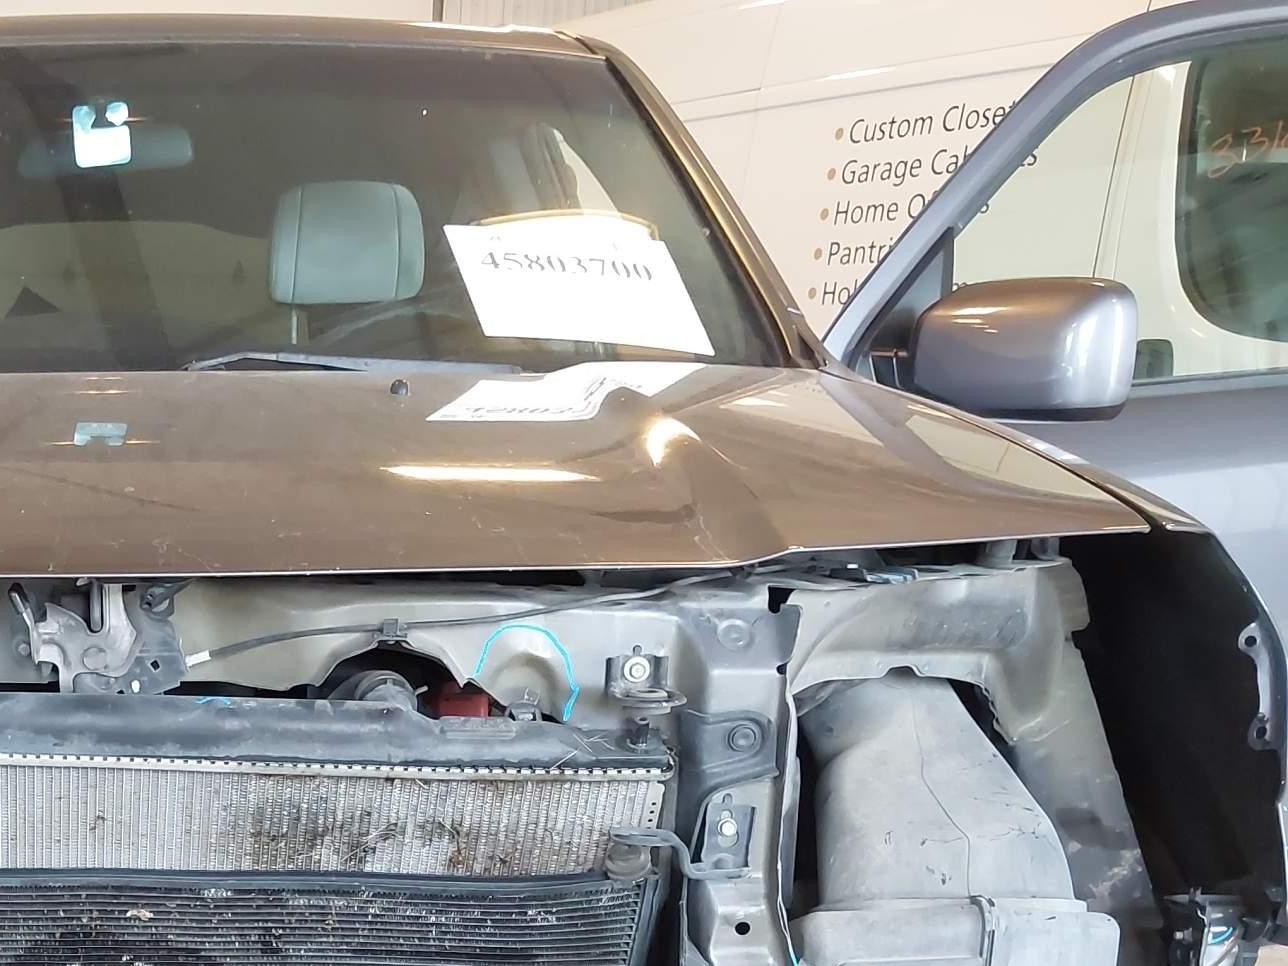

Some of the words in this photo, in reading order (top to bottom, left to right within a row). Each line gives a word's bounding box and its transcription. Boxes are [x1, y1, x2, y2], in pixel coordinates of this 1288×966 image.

[849, 114, 933, 144] Custom
[841, 158, 922, 187] Garage
[833, 200, 900, 226] Home
[480, 251, 653, 281] 45803700
